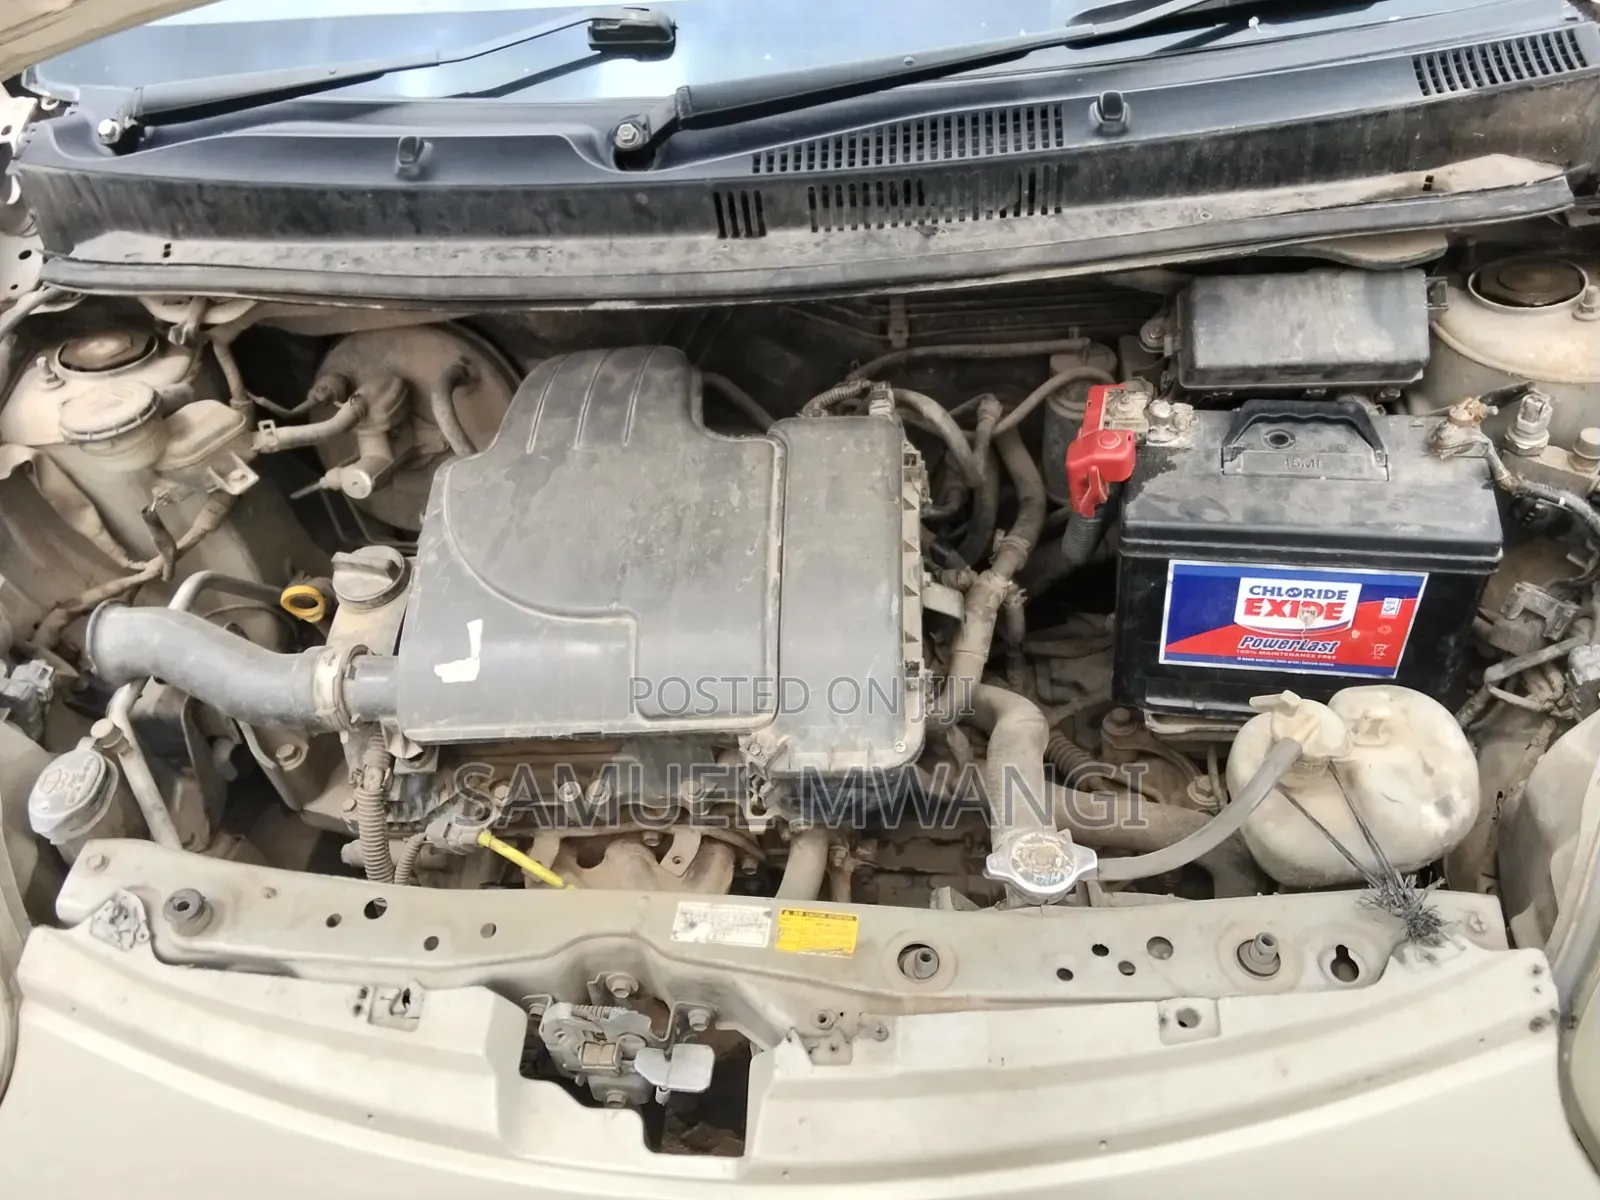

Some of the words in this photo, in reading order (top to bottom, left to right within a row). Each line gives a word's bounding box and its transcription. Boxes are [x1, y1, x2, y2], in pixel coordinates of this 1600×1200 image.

[1249, 585, 1349, 600] CHLORIDE
[1244, 598, 1346, 620] EXIDE
[1238, 635, 1340, 654] PowerLast
[1259, 650, 1315, 659] MAINTENANCE
